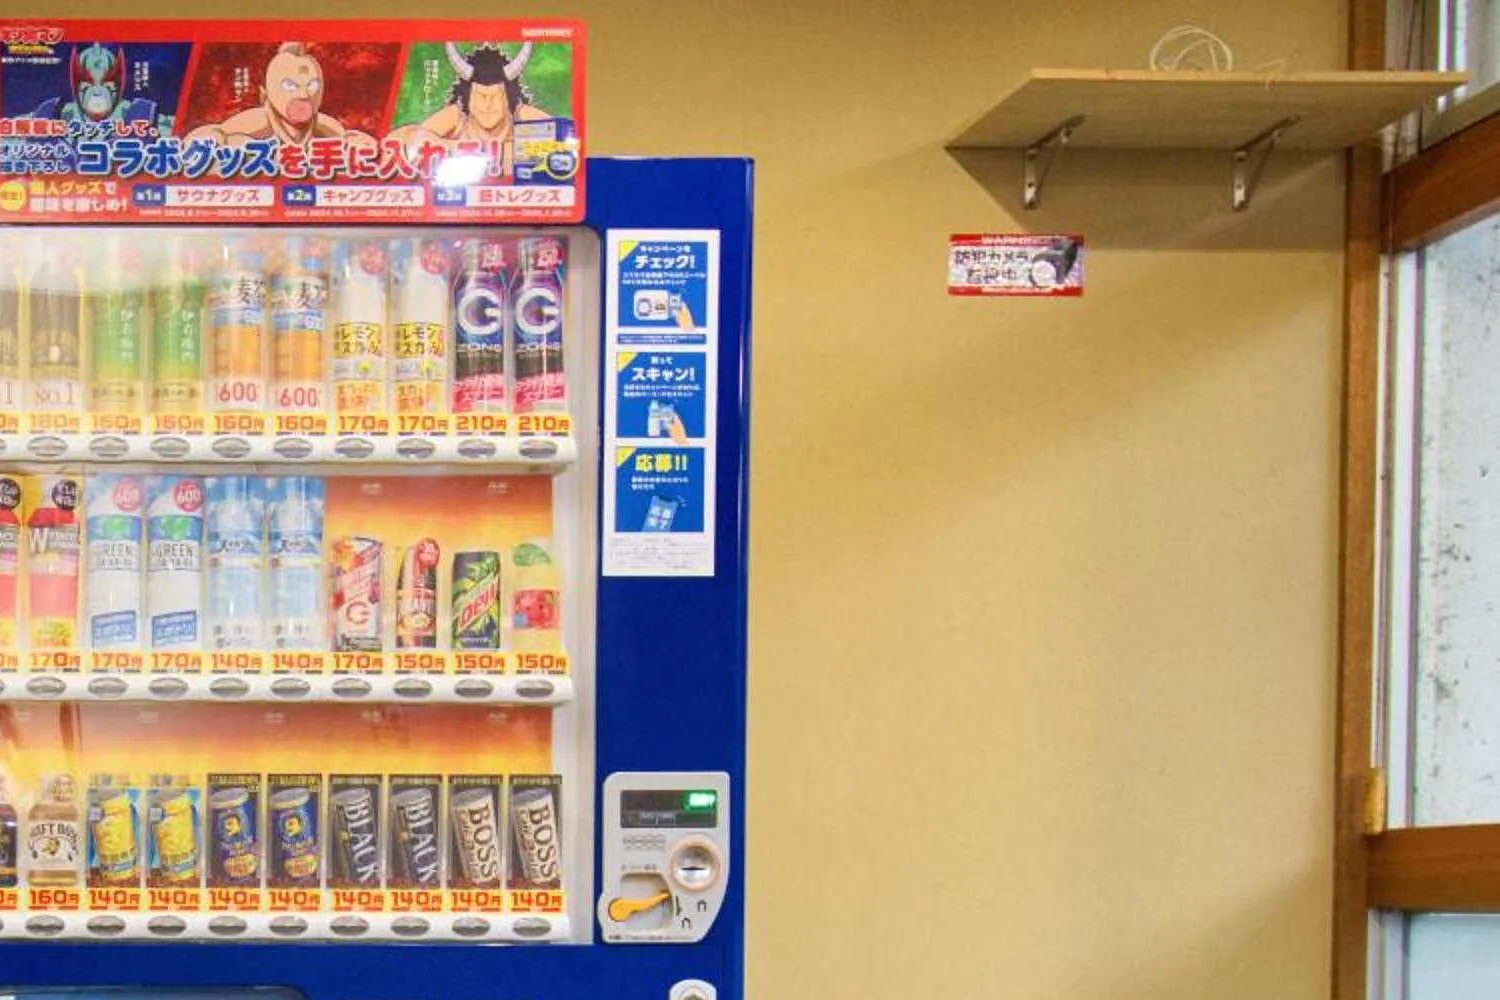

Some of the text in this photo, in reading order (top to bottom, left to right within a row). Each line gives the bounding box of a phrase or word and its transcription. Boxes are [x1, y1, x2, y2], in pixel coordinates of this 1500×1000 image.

[177, 189, 260, 202] サウナグッズ
[324, 189, 415, 203] キャンプグッズ
[636, 255, 695, 269] チェック!
[632, 367, 695, 381] スキャン!
[219, 382, 257, 402] 600
[280, 388, 318, 407] 600
[215, 414, 265, 430] 160円
[276, 416, 326, 431] 160円
[338, 416, 389, 431] 170円
[399, 416, 449, 431] 170円
[456, 416, 507, 431] 210円
[518, 416, 570, 431] 210円
[31, 652, 81, 668] 170円
[92, 652, 142, 668] 170円
[152, 652, 202, 668] 170円
[211, 654, 262, 669] 140円
[273, 654, 323, 669] 140円
[334, 654, 383, 669] 170円
[395, 654, 445, 669] 150円
[455, 654, 505, 669] 150円
[517, 654, 567, 669] 150円
[343, 797, 378, 883] BLACK
[405, 798, 439, 884] BLACK
[469, 803, 499, 877] BOSS
[529, 804, 558, 878] BOSS
[29, 888, 79, 904] 160円
[90, 889, 140, 905] 140円
[150, 889, 200, 905] 140円
[209, 889, 260, 905] 140円
[270, 891, 320, 906] 140円
[334, 891, 384, 906] 140円
[392, 891, 442, 906] 140円
[452, 891, 502, 906] 140円
[512, 891, 562, 906] 140円
